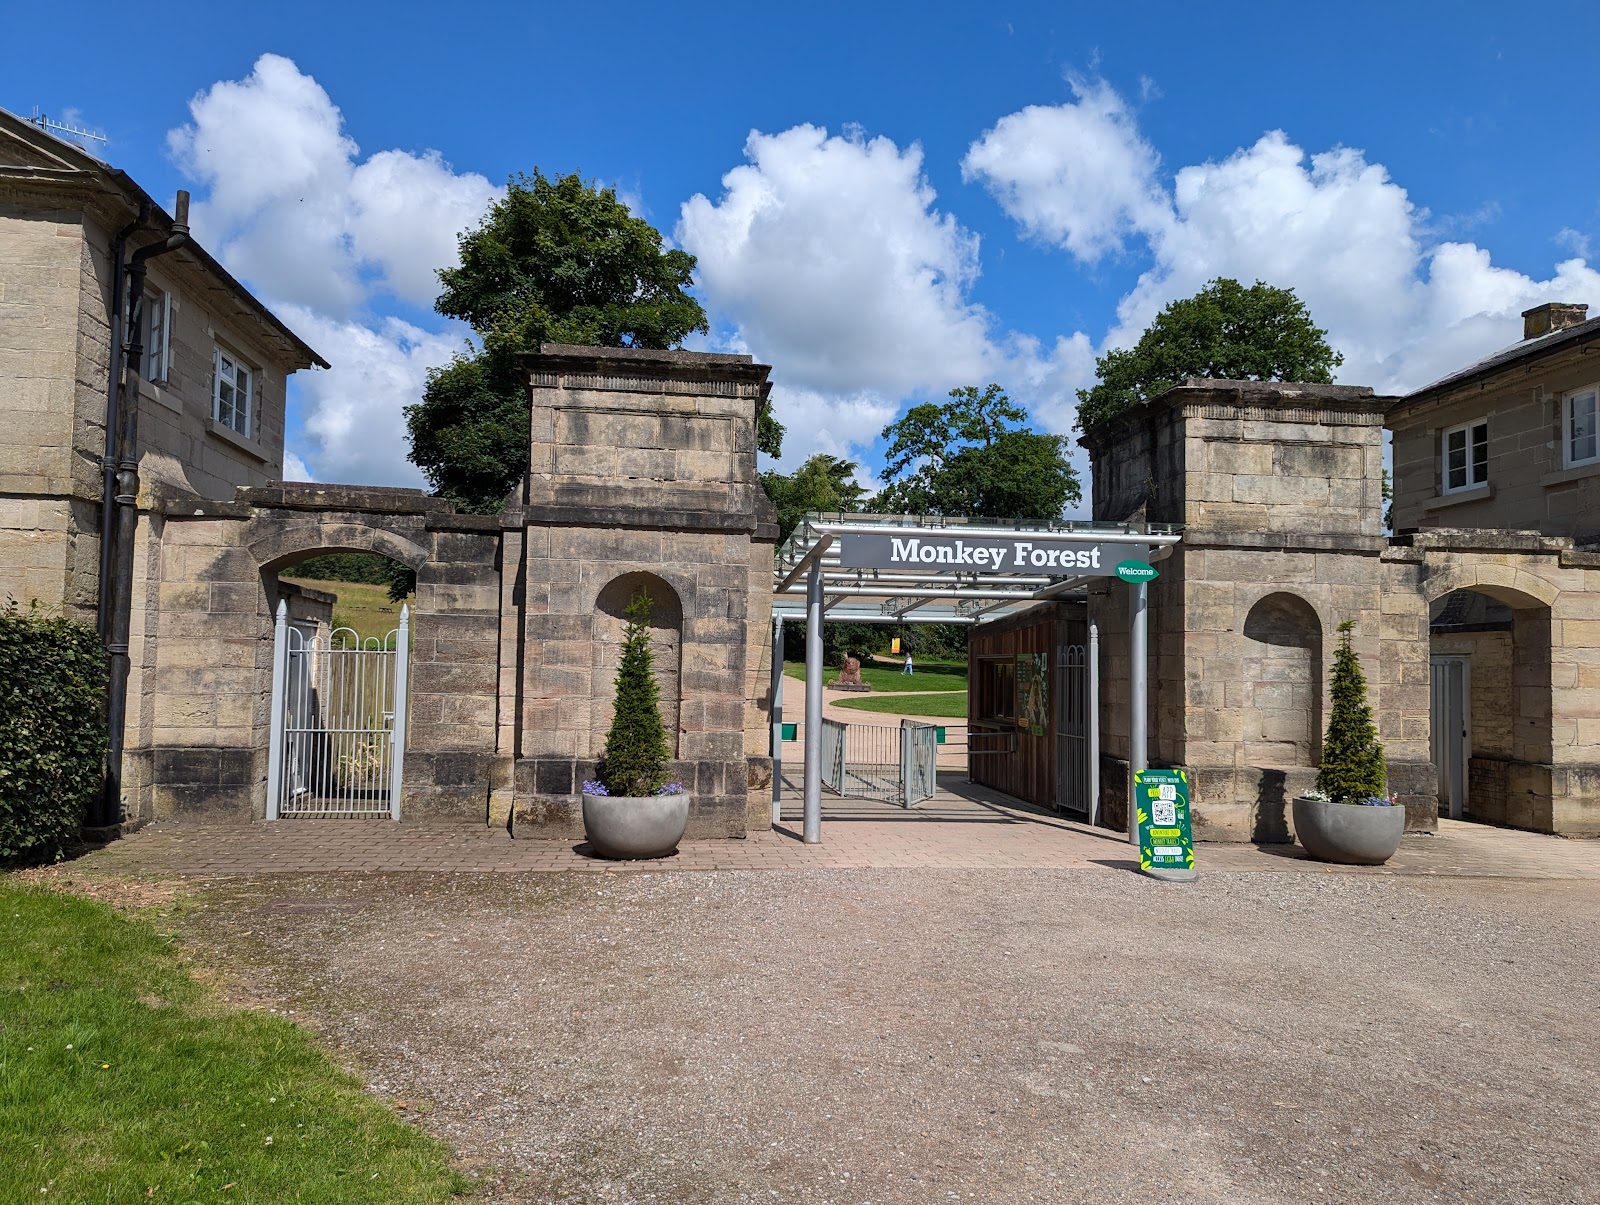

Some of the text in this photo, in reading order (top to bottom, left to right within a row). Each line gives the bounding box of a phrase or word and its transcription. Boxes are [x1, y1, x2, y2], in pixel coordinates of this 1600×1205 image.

[890, 538, 1101, 570] Monkey Forest
[1118, 567, 1154, 576] Welcome
[1161, 786, 1174, 799] APP
